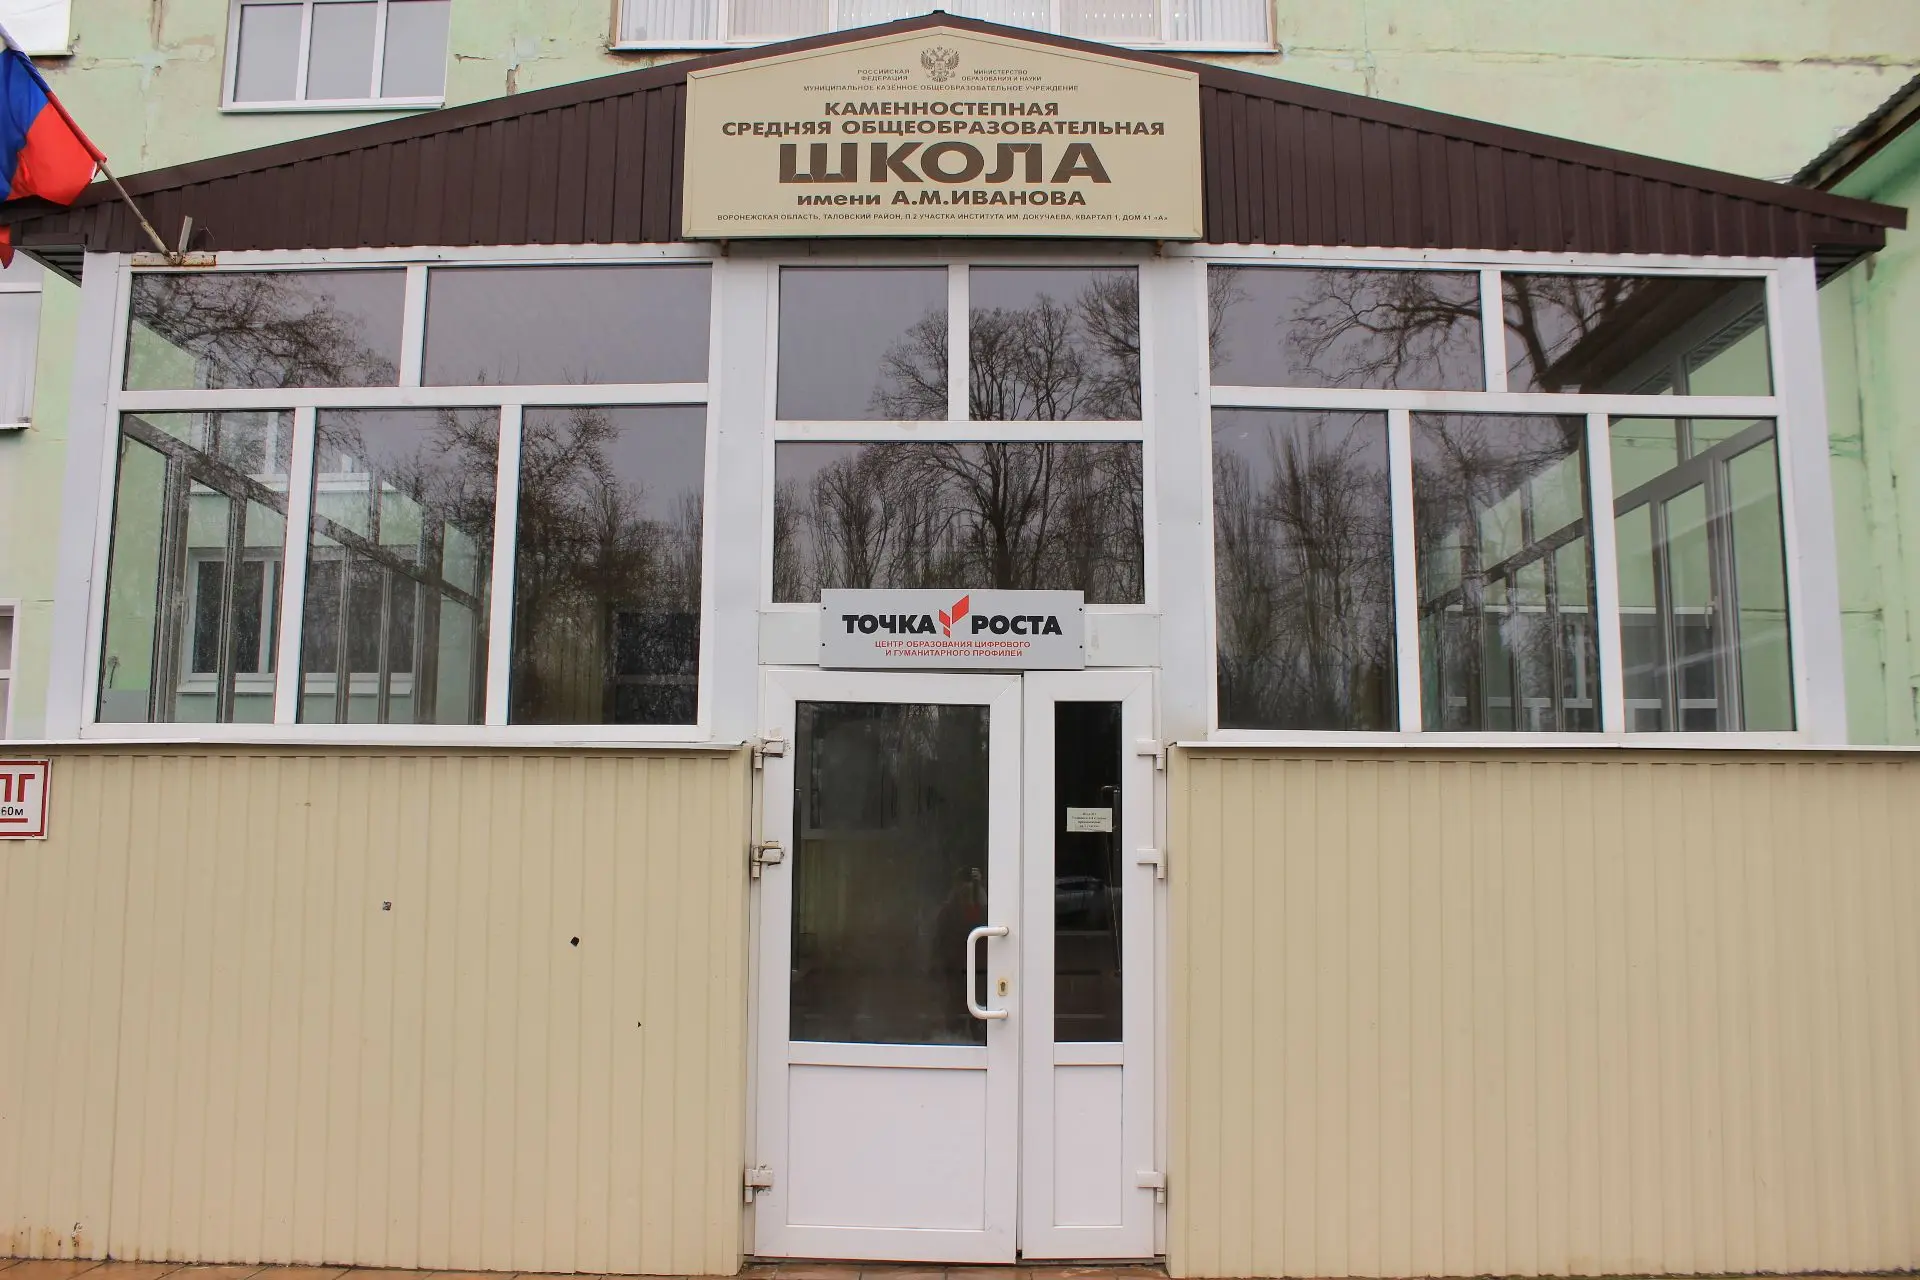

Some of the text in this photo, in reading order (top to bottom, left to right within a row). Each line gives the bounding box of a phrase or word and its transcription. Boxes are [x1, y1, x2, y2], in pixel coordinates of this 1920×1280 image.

[920, 84, 1023, 92] ОБЩЕОБРАЗОВАТЕЛЬНОЕ
[825, 102, 1059, 116] КАМЕННОСТЕПНАЯ
[722, 120, 1165, 138] СРЕДНЯЯ ОБЩЕОБРАЗОВАТЕЛЬНАЯ
[779, 141, 1111, 183] ШКОЛА
[797, 190, 1087, 206] имени А.М.ИВАНОВА
[873, 212, 903, 220] РАЙОН,
[1122, 214, 1141, 222] ДОМ
[842, 614, 1062, 635] ТОЧКА РОСТА
[875, 640, 1031, 649] ЦЕНТР ОБРАЗОВАНИЯ ЦИФРОВОГО
[885, 649, 1023, 657] И ГУМАНИТАРНОГО ПРОФИЛЕЙ
